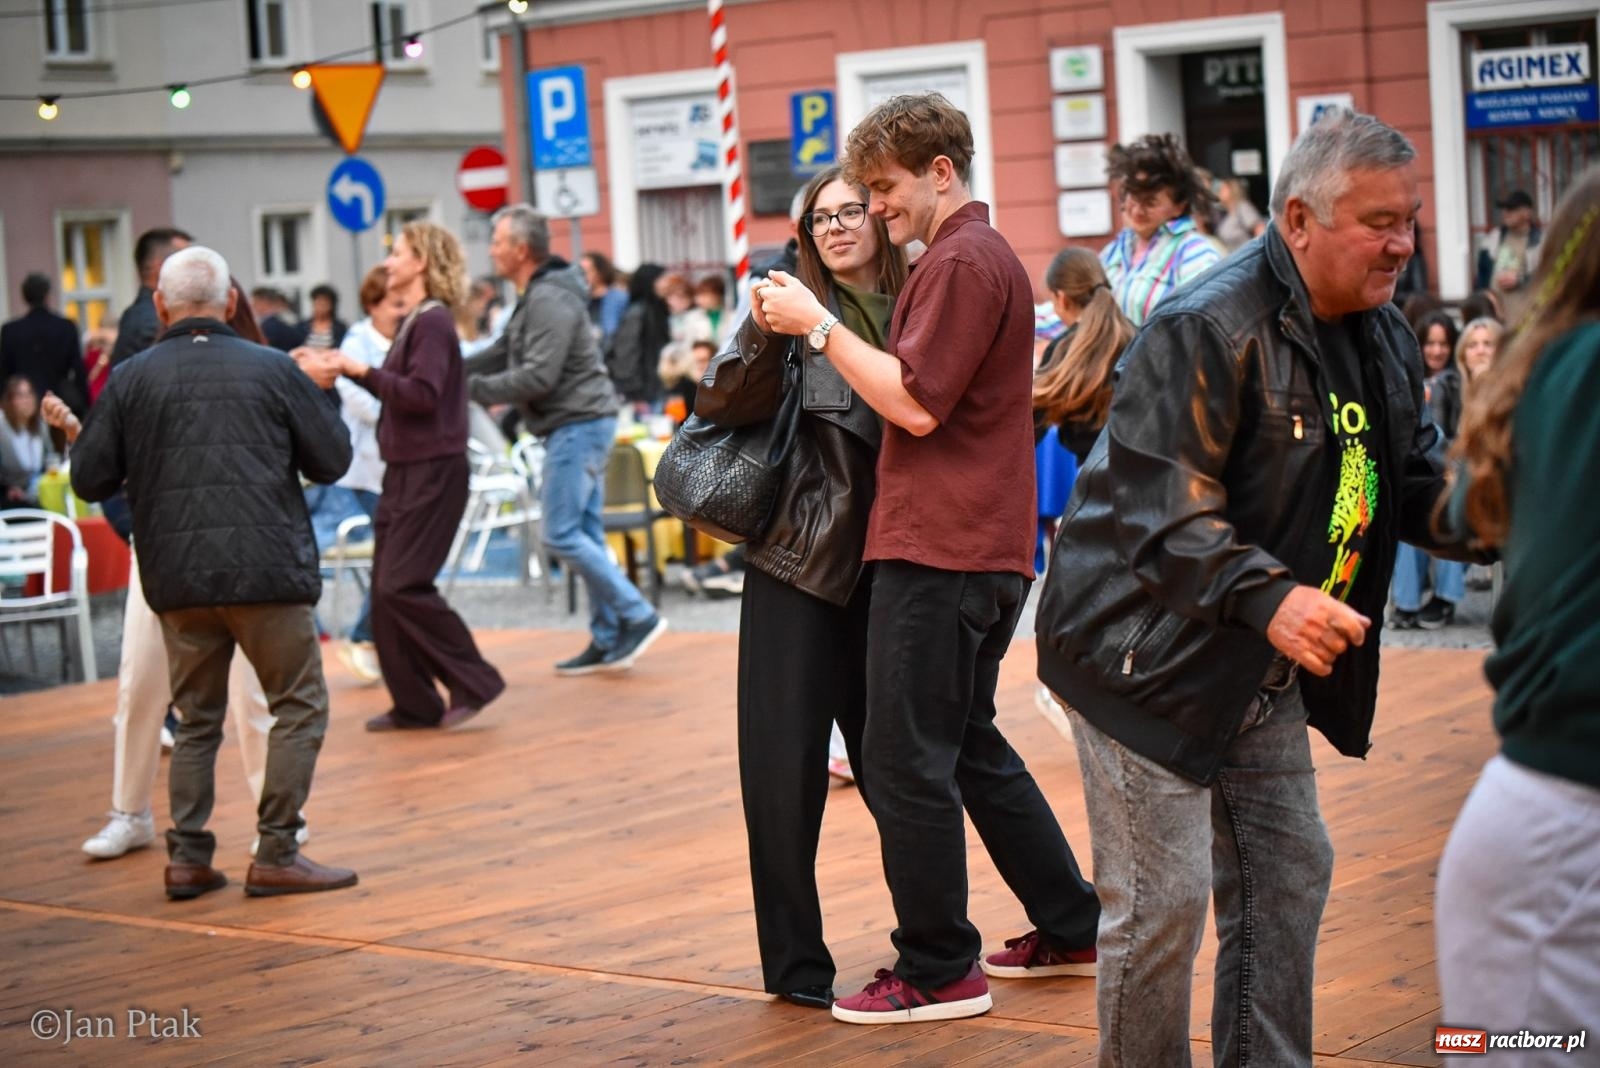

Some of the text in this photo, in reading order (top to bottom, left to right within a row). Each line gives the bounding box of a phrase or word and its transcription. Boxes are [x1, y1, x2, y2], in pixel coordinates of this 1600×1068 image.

[1478, 51, 1583, 83] AGIMEX
[538, 75, 576, 141] P
[802, 95, 828, 133] P
